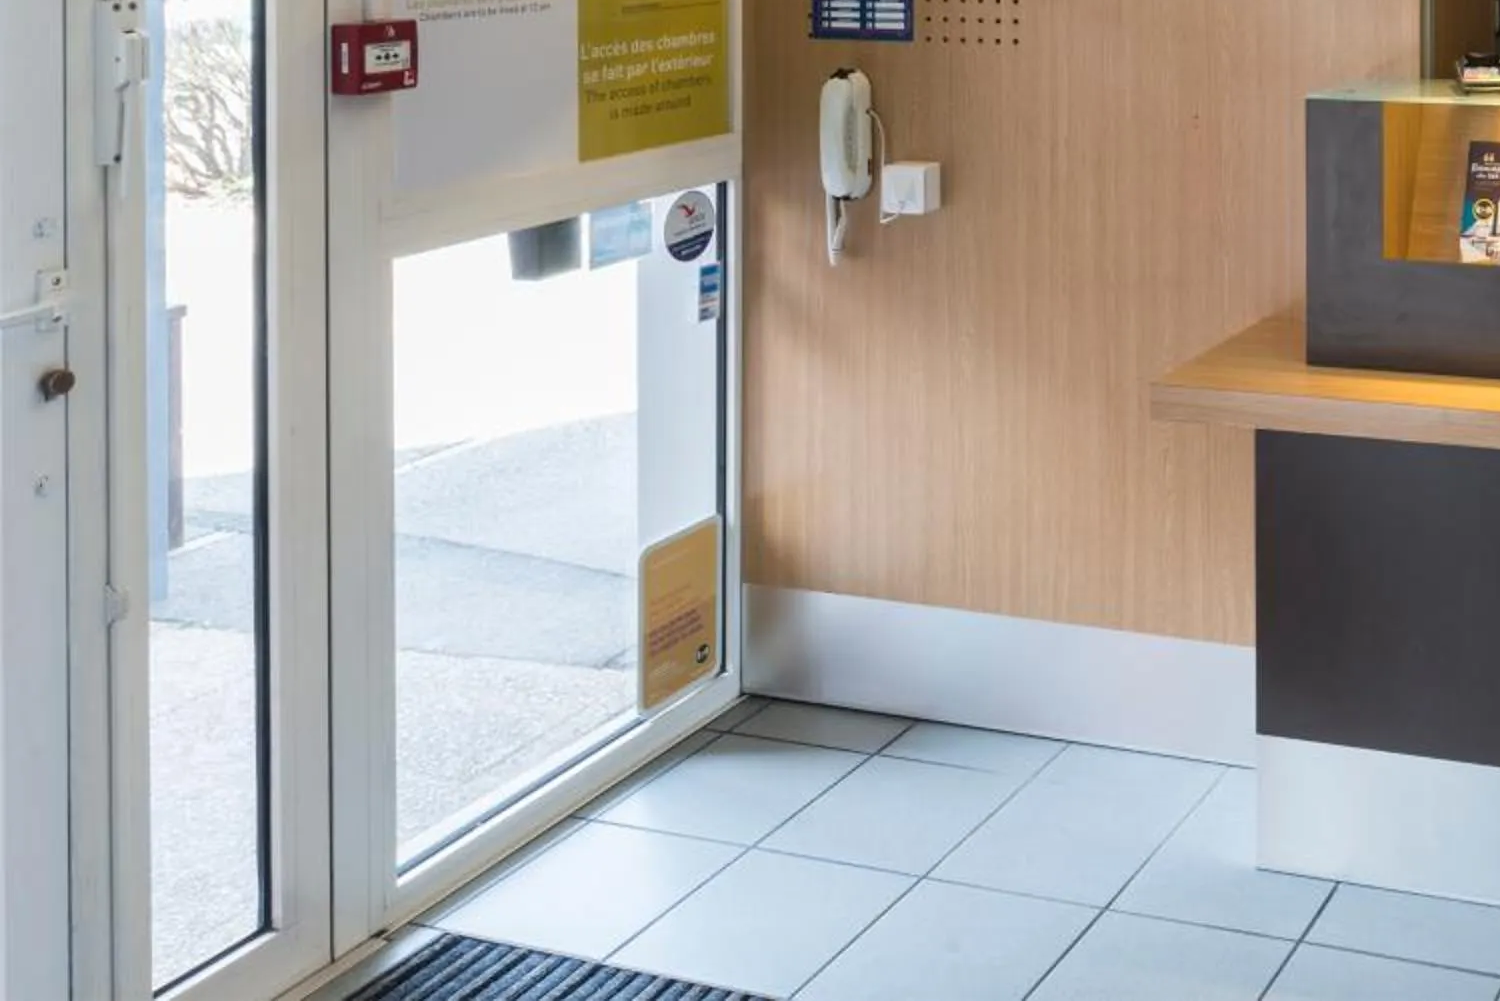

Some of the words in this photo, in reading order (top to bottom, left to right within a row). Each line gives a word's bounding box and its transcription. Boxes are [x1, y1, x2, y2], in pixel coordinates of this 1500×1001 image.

[631, 38, 654, 53] des
[656, 31, 715, 50] chambres
[602, 63, 625, 81] fait
[626, 61, 649, 81] par
